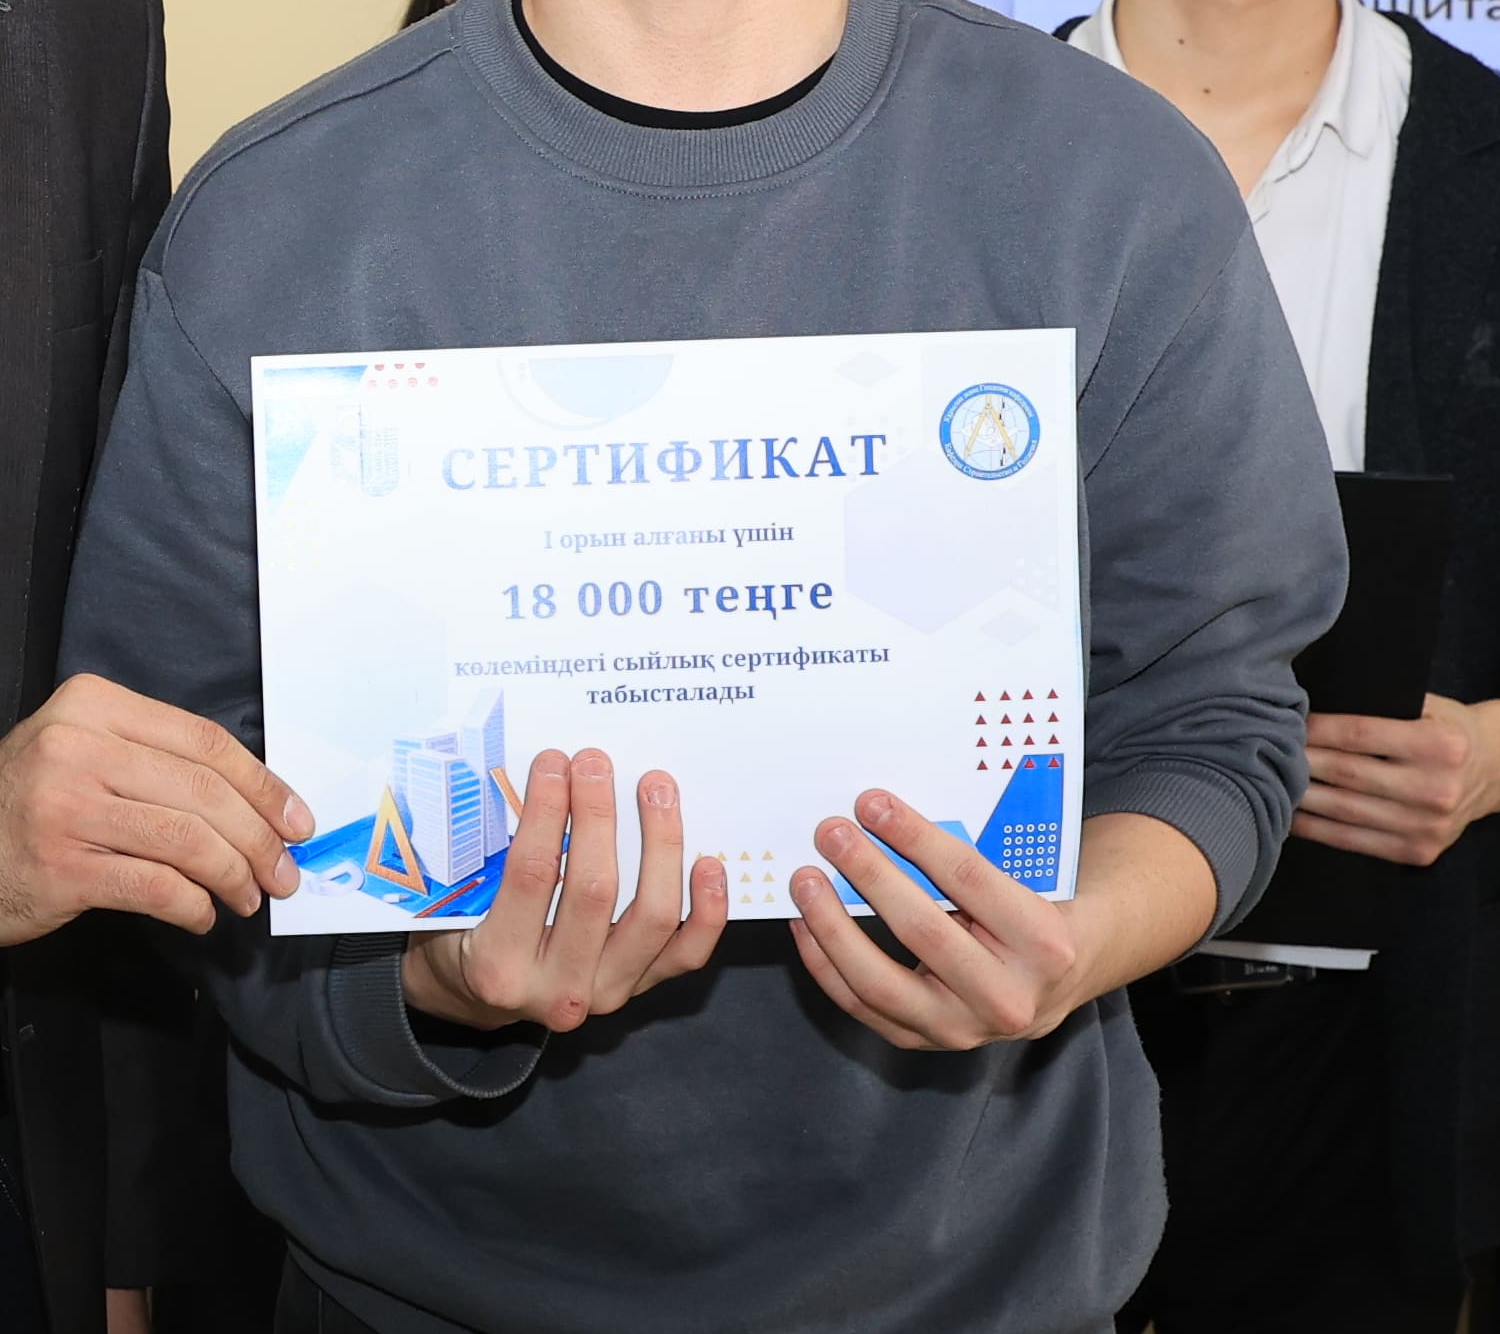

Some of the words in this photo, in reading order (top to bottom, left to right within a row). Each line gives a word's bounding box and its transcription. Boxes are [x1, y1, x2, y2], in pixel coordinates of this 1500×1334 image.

[441, 434, 888, 491] СЕРТИФИКАТ
[559, 532, 628, 554] орын
[633, 528, 727, 547] алғаны
[732, 522, 795, 548] үшін
[501, 583, 557, 620] 18
[577, 580, 664, 618] 000
[684, 581, 834, 620] теңге
[454, 651, 607, 679] көлеміндегі
[612, 651, 716, 673] сыйлық
[721, 645, 890, 672] сертификаты
[586, 683, 756, 705] табысталады
